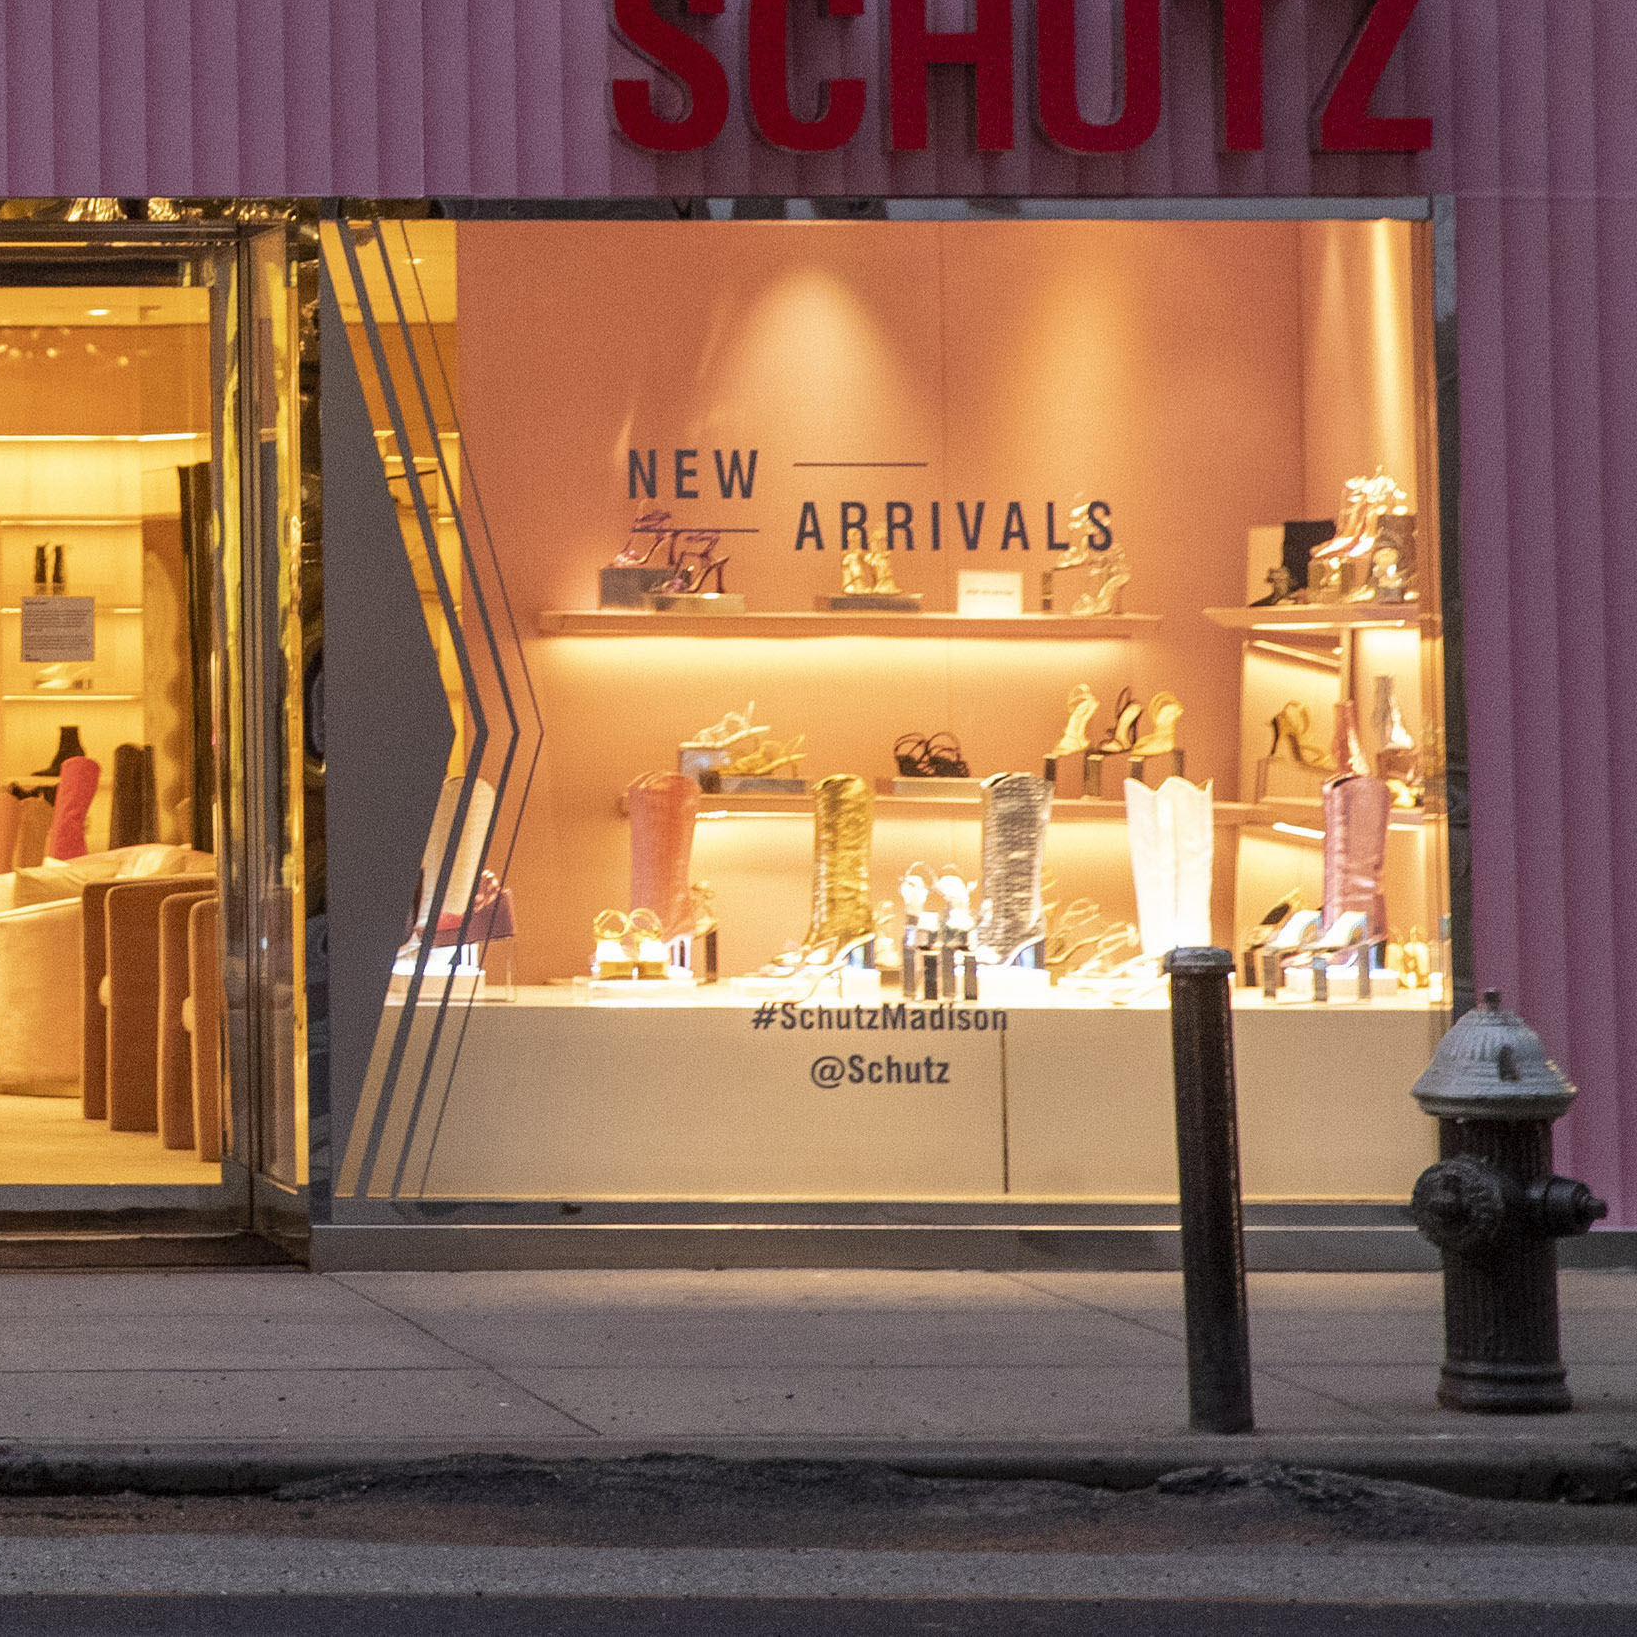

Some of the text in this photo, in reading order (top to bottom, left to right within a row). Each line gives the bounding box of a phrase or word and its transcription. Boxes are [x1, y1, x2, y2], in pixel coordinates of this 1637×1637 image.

[628, 449, 759, 499] NEW
[795, 501, 1114, 551] ARRIVALS
[752, 1002, 1008, 1031] #SchutzMadison
[811, 1055, 950, 1089] @Schutz
